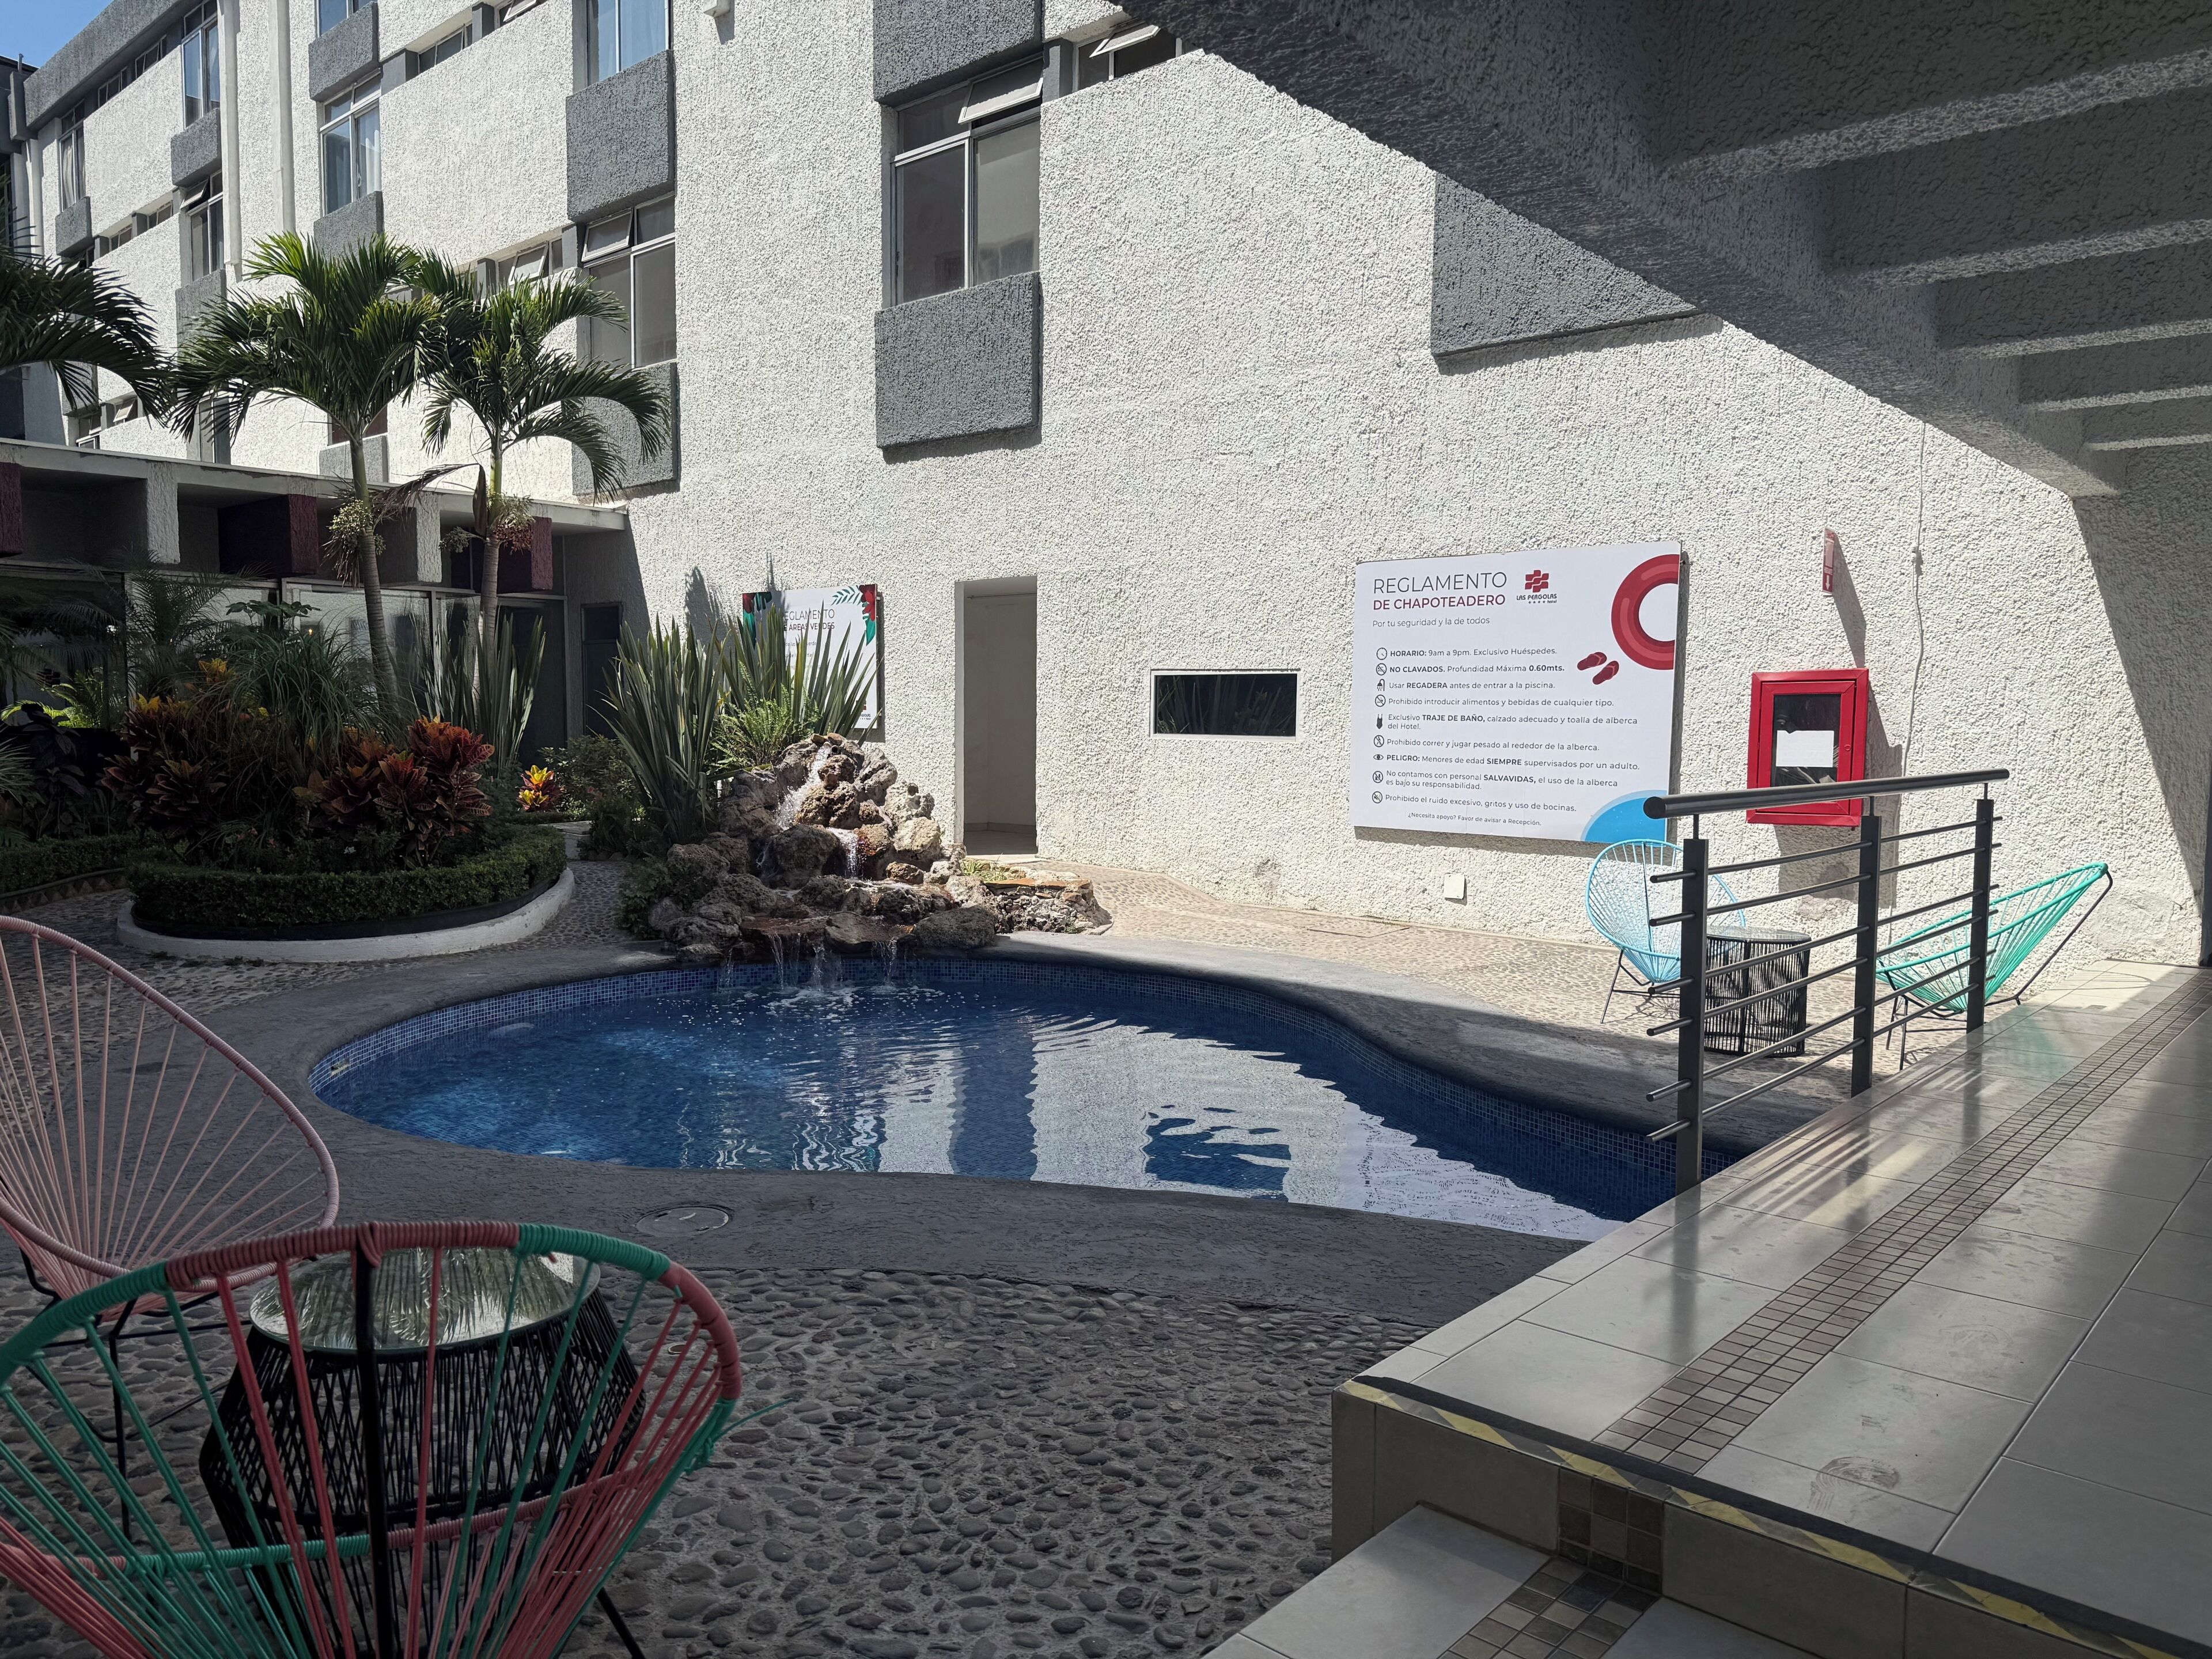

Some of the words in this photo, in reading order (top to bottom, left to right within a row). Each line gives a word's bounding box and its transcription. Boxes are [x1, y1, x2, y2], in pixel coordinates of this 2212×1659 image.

[1374, 572, 1507, 594] REGLAMENTO
[1373, 600, 1390, 610] DE
[1394, 594, 1505, 609] CHAPOTEADERO
[784, 609, 835, 620] EGLAMENTO
[810, 622, 835, 630] VEDES
[1397, 618, 1436, 628] seguridad
[1467, 616, 1490, 624] todos
[1511, 647, 1557, 656] Huéspedes.
[1525, 681, 1555, 690] piscina.
[1554, 699, 1593, 707] cualquier
[1596, 699, 1613, 707] tipo.
[1460, 714, 1485, 722] BAÑO,
[1451, 740, 1471, 748] jugar
[1396, 779, 1410, 787] bajo
[1484, 774, 1536, 783] SALVAVIDAS,
[1543, 803, 1576, 812] bocinas.
